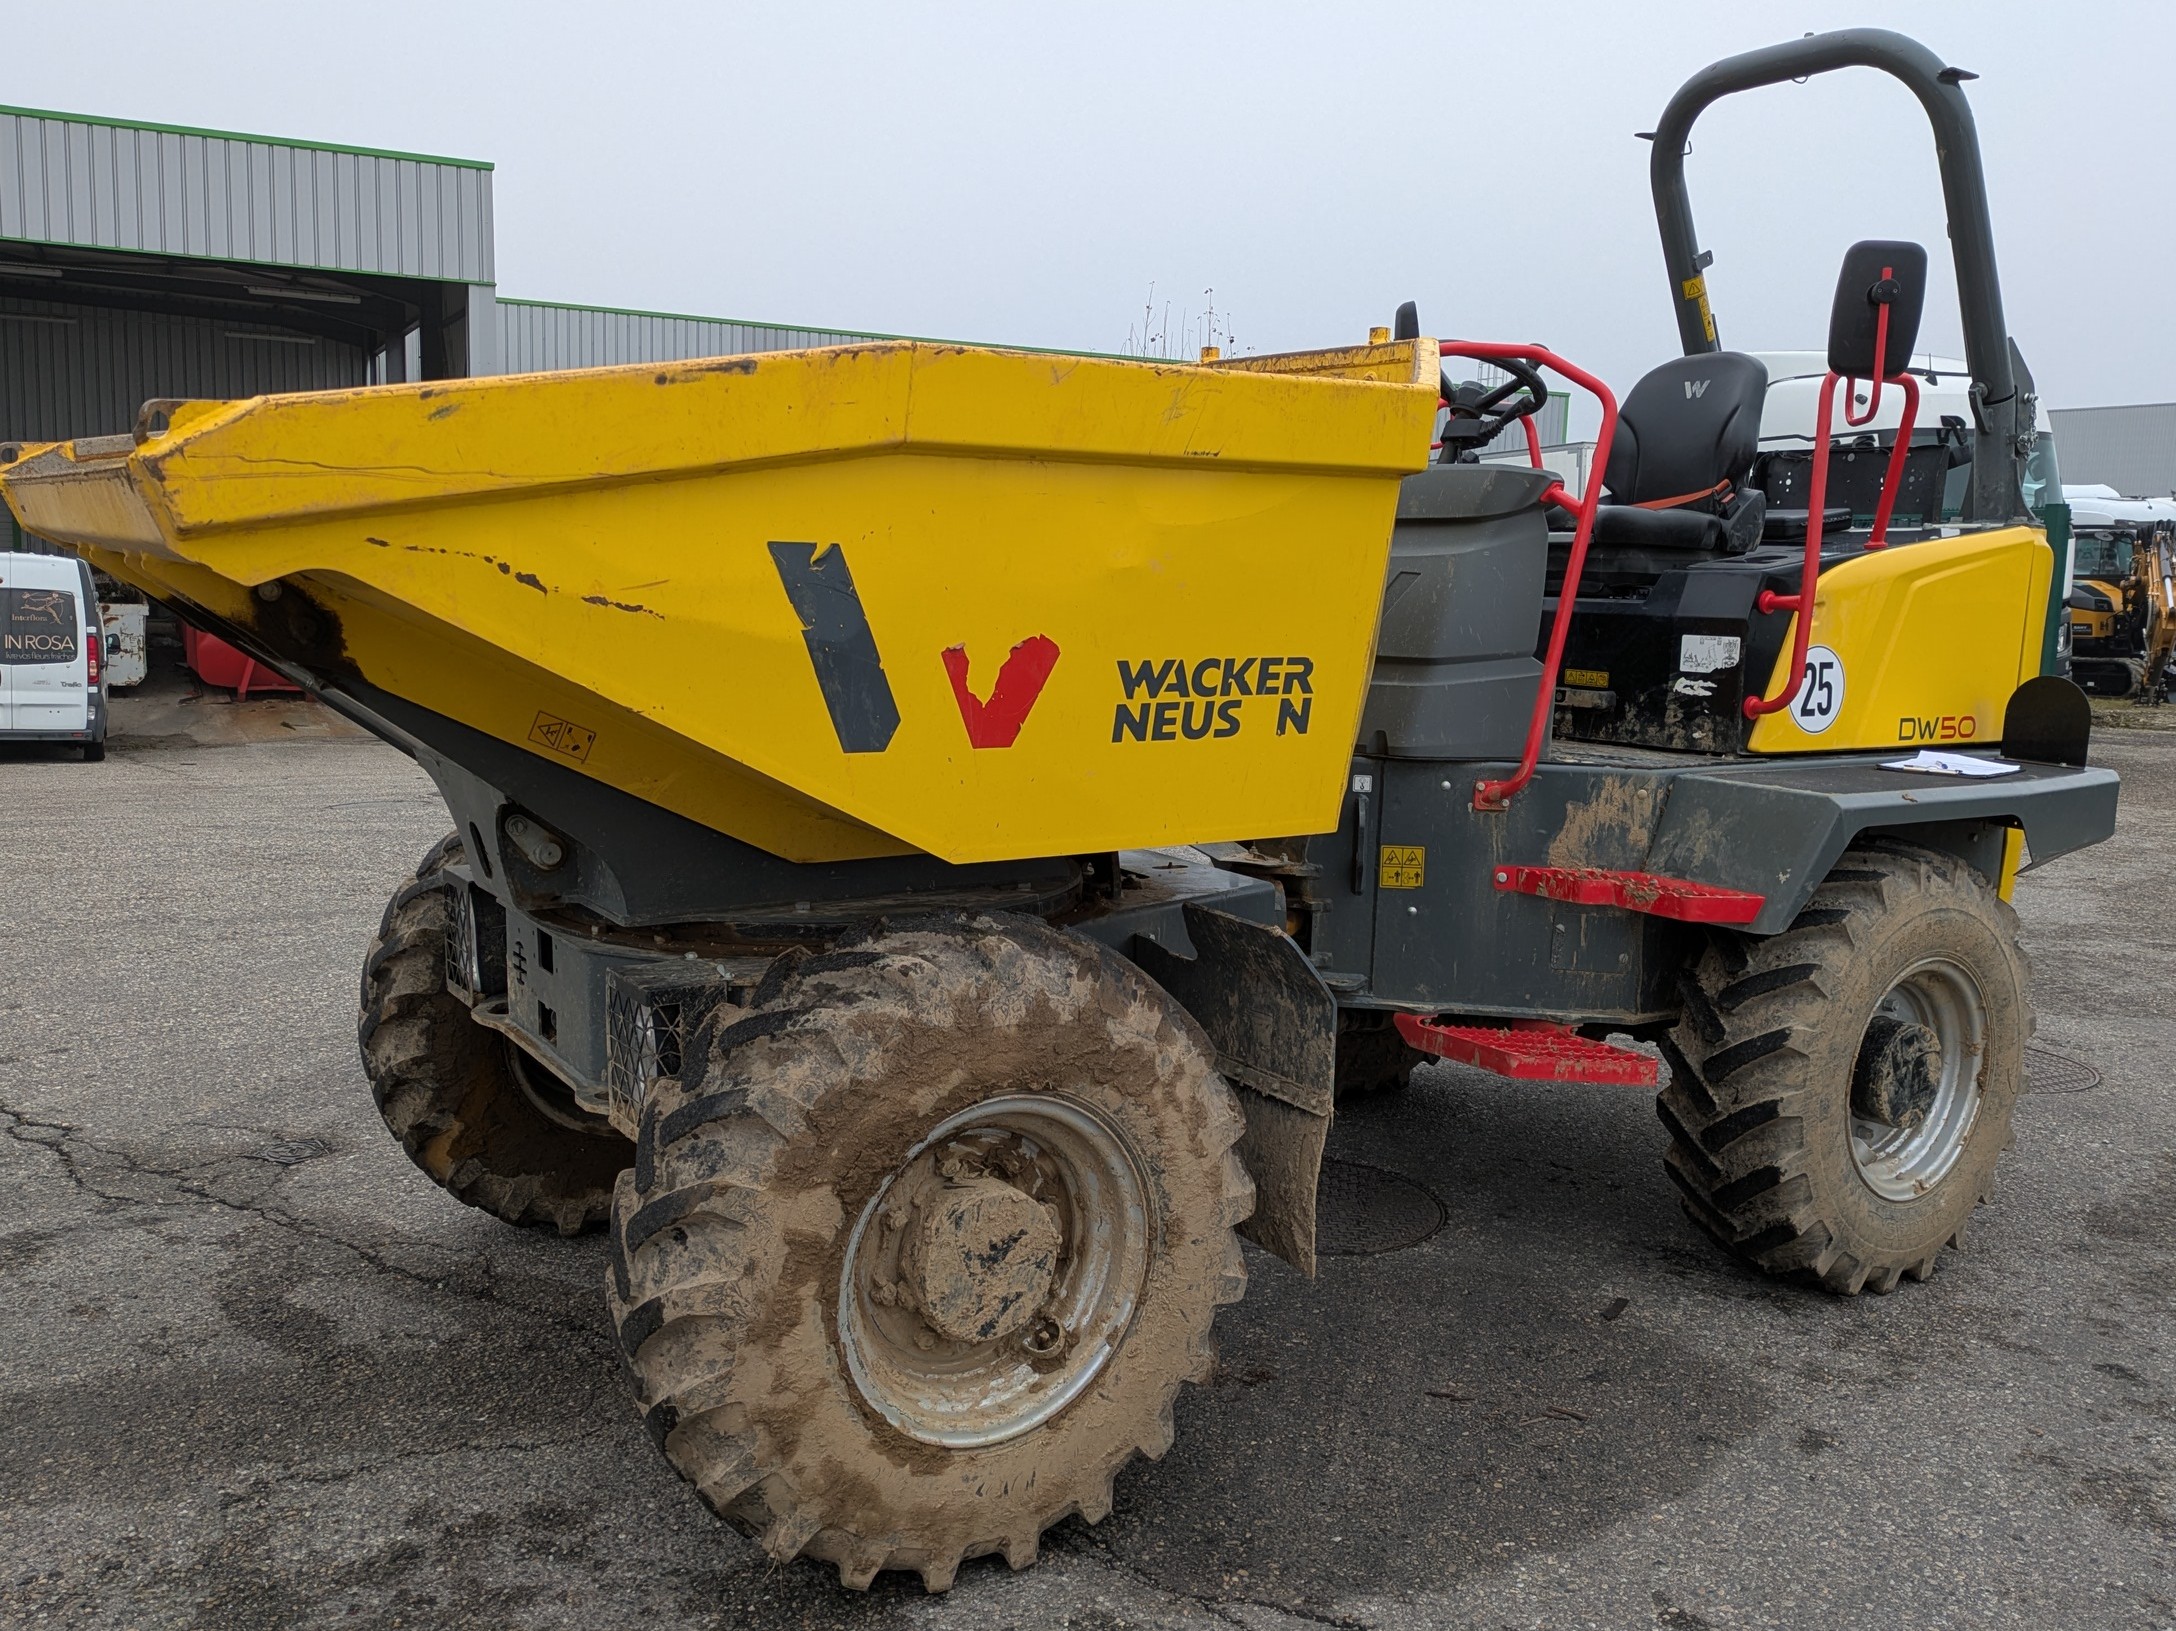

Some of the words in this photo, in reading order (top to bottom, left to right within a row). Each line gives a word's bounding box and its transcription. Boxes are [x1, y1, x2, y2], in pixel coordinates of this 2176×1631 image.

[11, 613, 48, 621] Interflora
[5, 634, 22, 649] IN
[25, 635, 75, 650] ROSA
[1116, 657, 1314, 700] WACKER
[1800, 662, 1834, 717] 25
[1111, 697, 1313, 744] NEUSN
[1898, 715, 1976, 741] DW50
